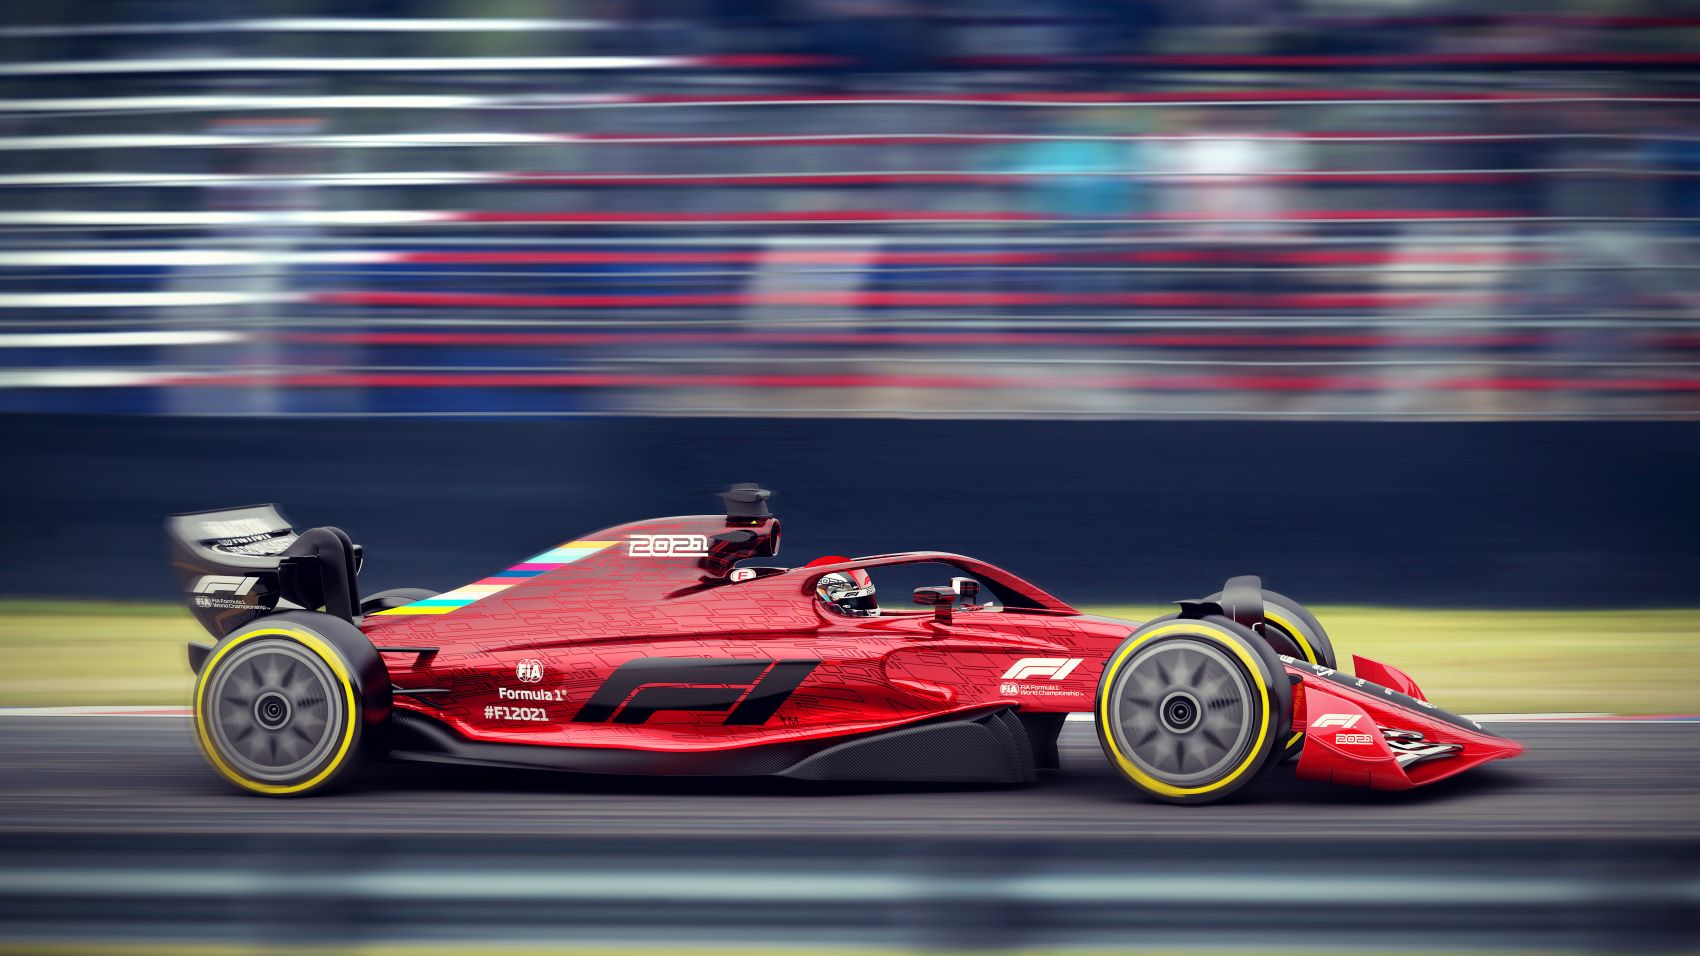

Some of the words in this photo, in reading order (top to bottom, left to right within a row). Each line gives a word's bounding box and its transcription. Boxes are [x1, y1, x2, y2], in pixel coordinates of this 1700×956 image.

[629, 534, 709, 557] 2021
[517, 662, 542, 680] FIA
[498, 687, 552, 701] Formula
[1001, 683, 1018, 695] FIA
[484, 705, 549, 721] #F12021
[1335, 733, 1374, 746] 2021
